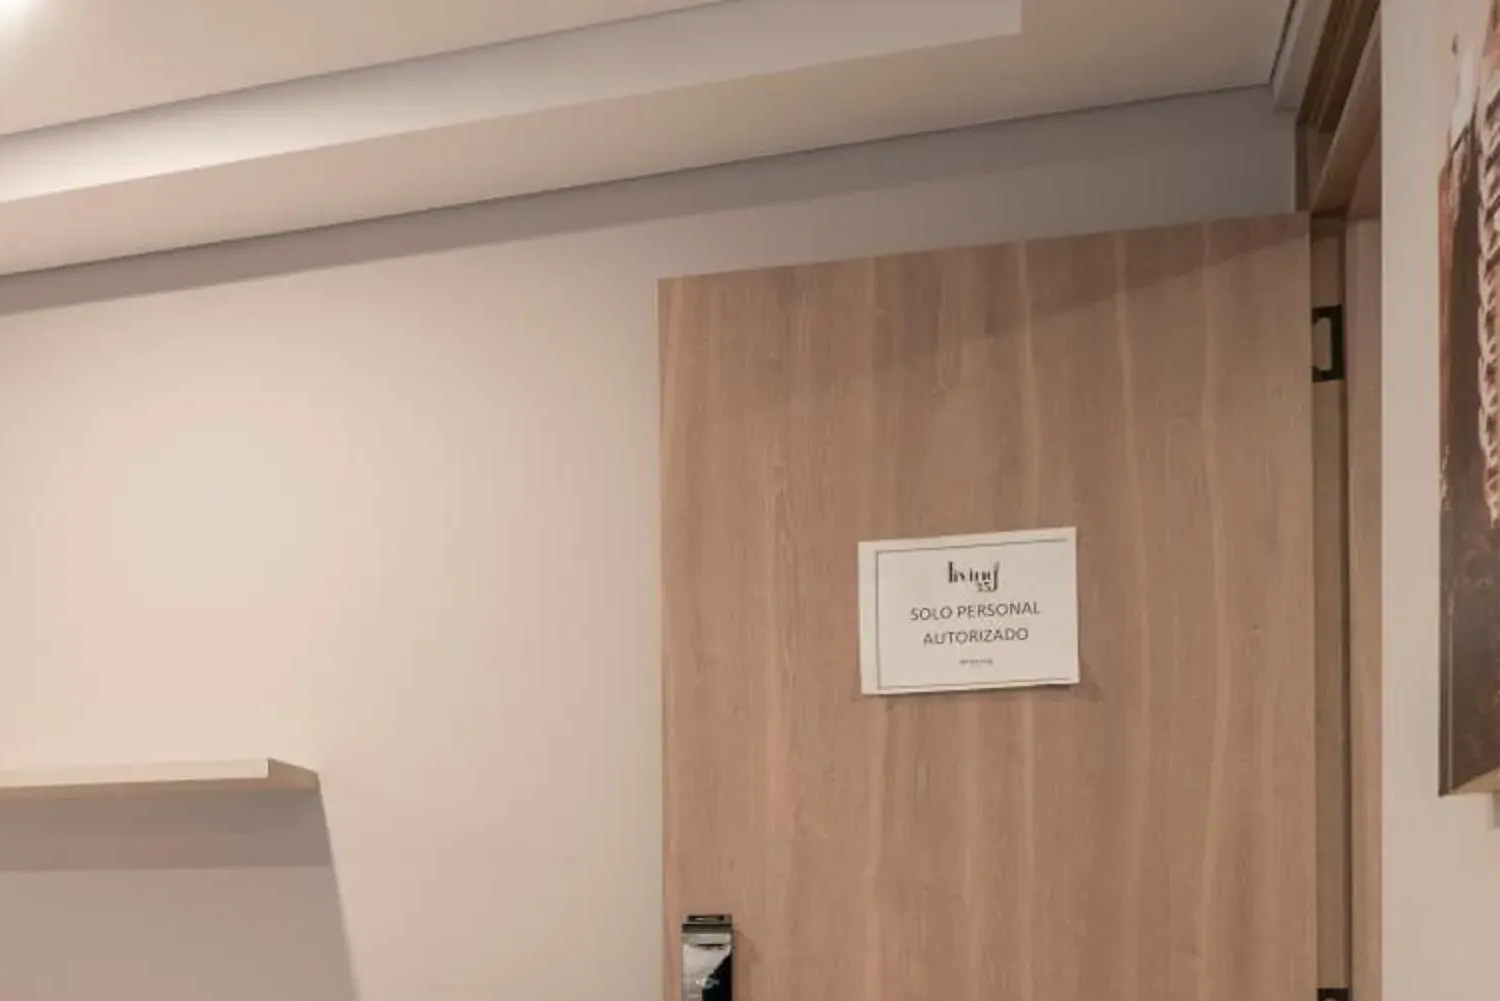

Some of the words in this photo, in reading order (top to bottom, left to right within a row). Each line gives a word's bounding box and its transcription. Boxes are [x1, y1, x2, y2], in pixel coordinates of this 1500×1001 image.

[909, 605, 953, 622] SOLO
[957, 601, 1041, 619] PERSONAL
[923, 627, 1030, 646] AUTORIZADO
